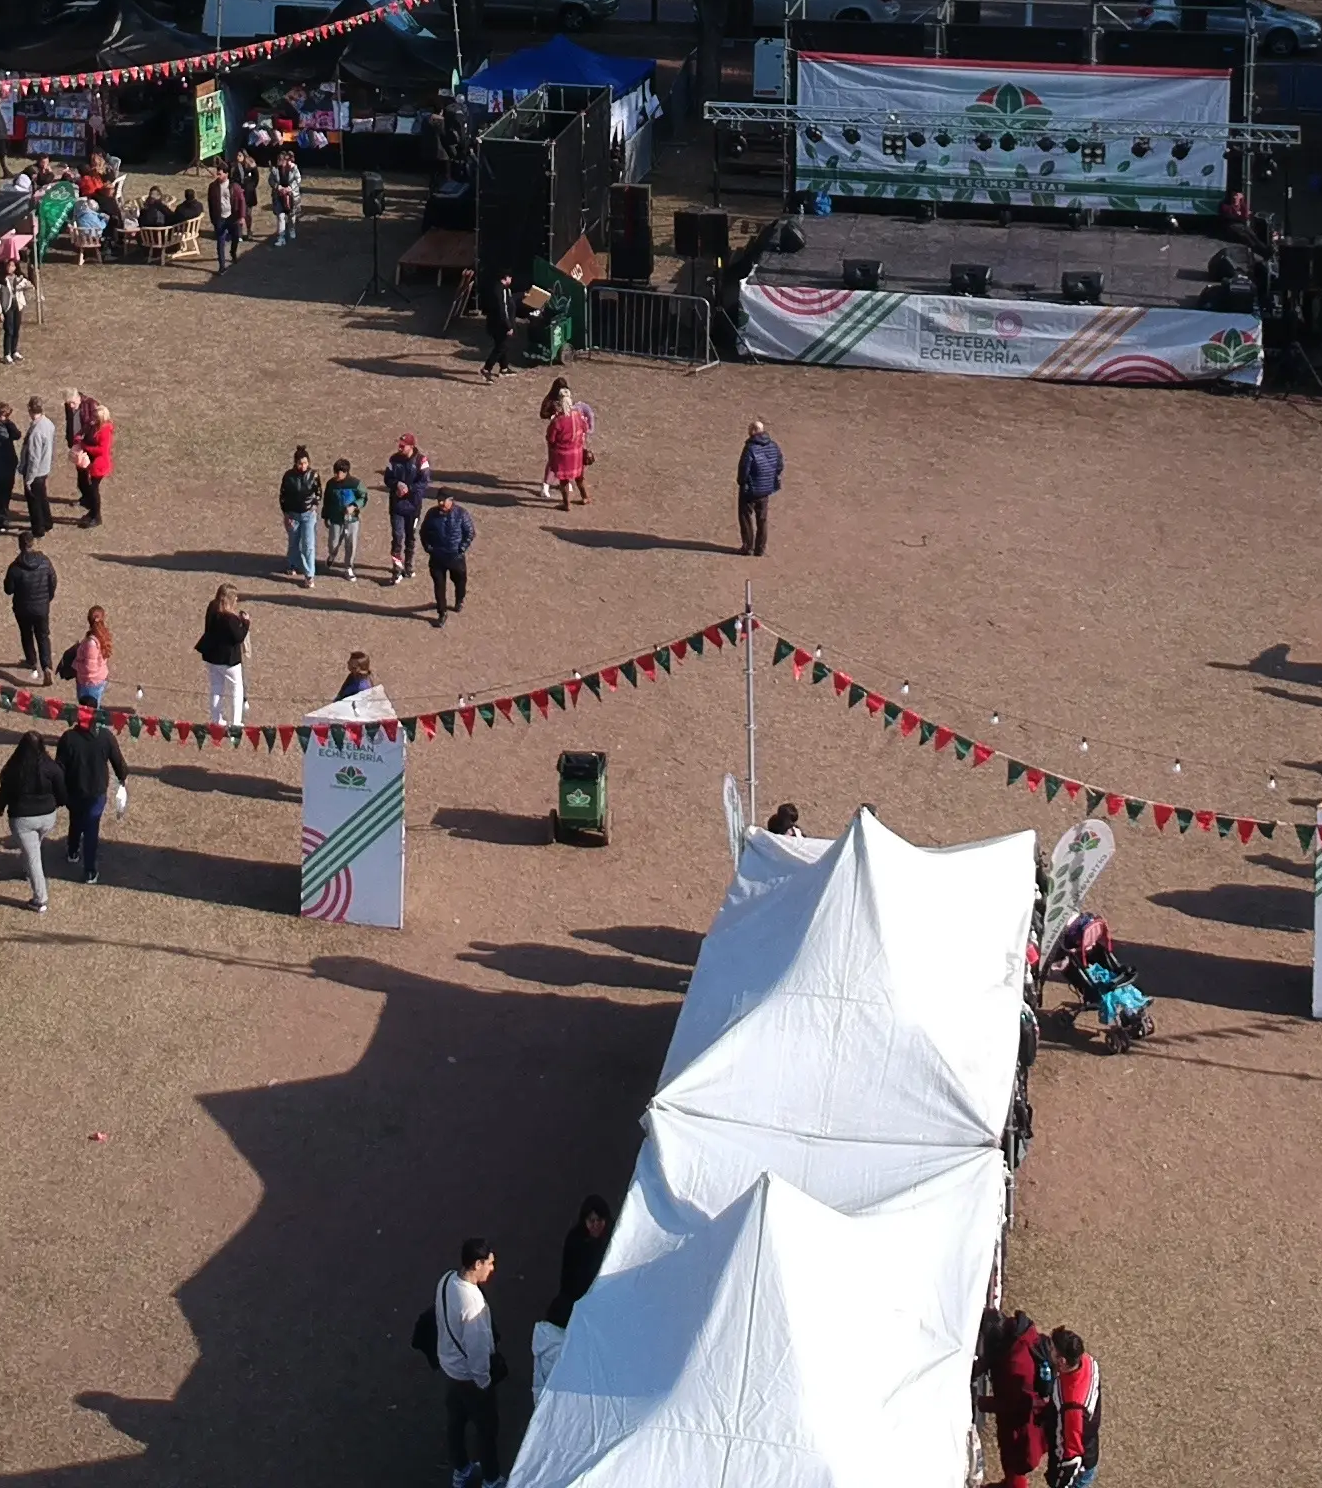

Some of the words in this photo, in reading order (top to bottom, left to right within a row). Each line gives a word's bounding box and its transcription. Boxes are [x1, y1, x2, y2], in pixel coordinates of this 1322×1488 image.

[949, 178, 1017, 190] ELEGIMOS
[1023, 180, 1066, 192] ESTAR
[920, 299, 1022, 340] EXPO
[934, 334, 1007, 349] ESTEBAN
[920, 347, 1022, 365] ECHEVERRÍA
[318, 748, 384, 763] ECHEVERRÍA
